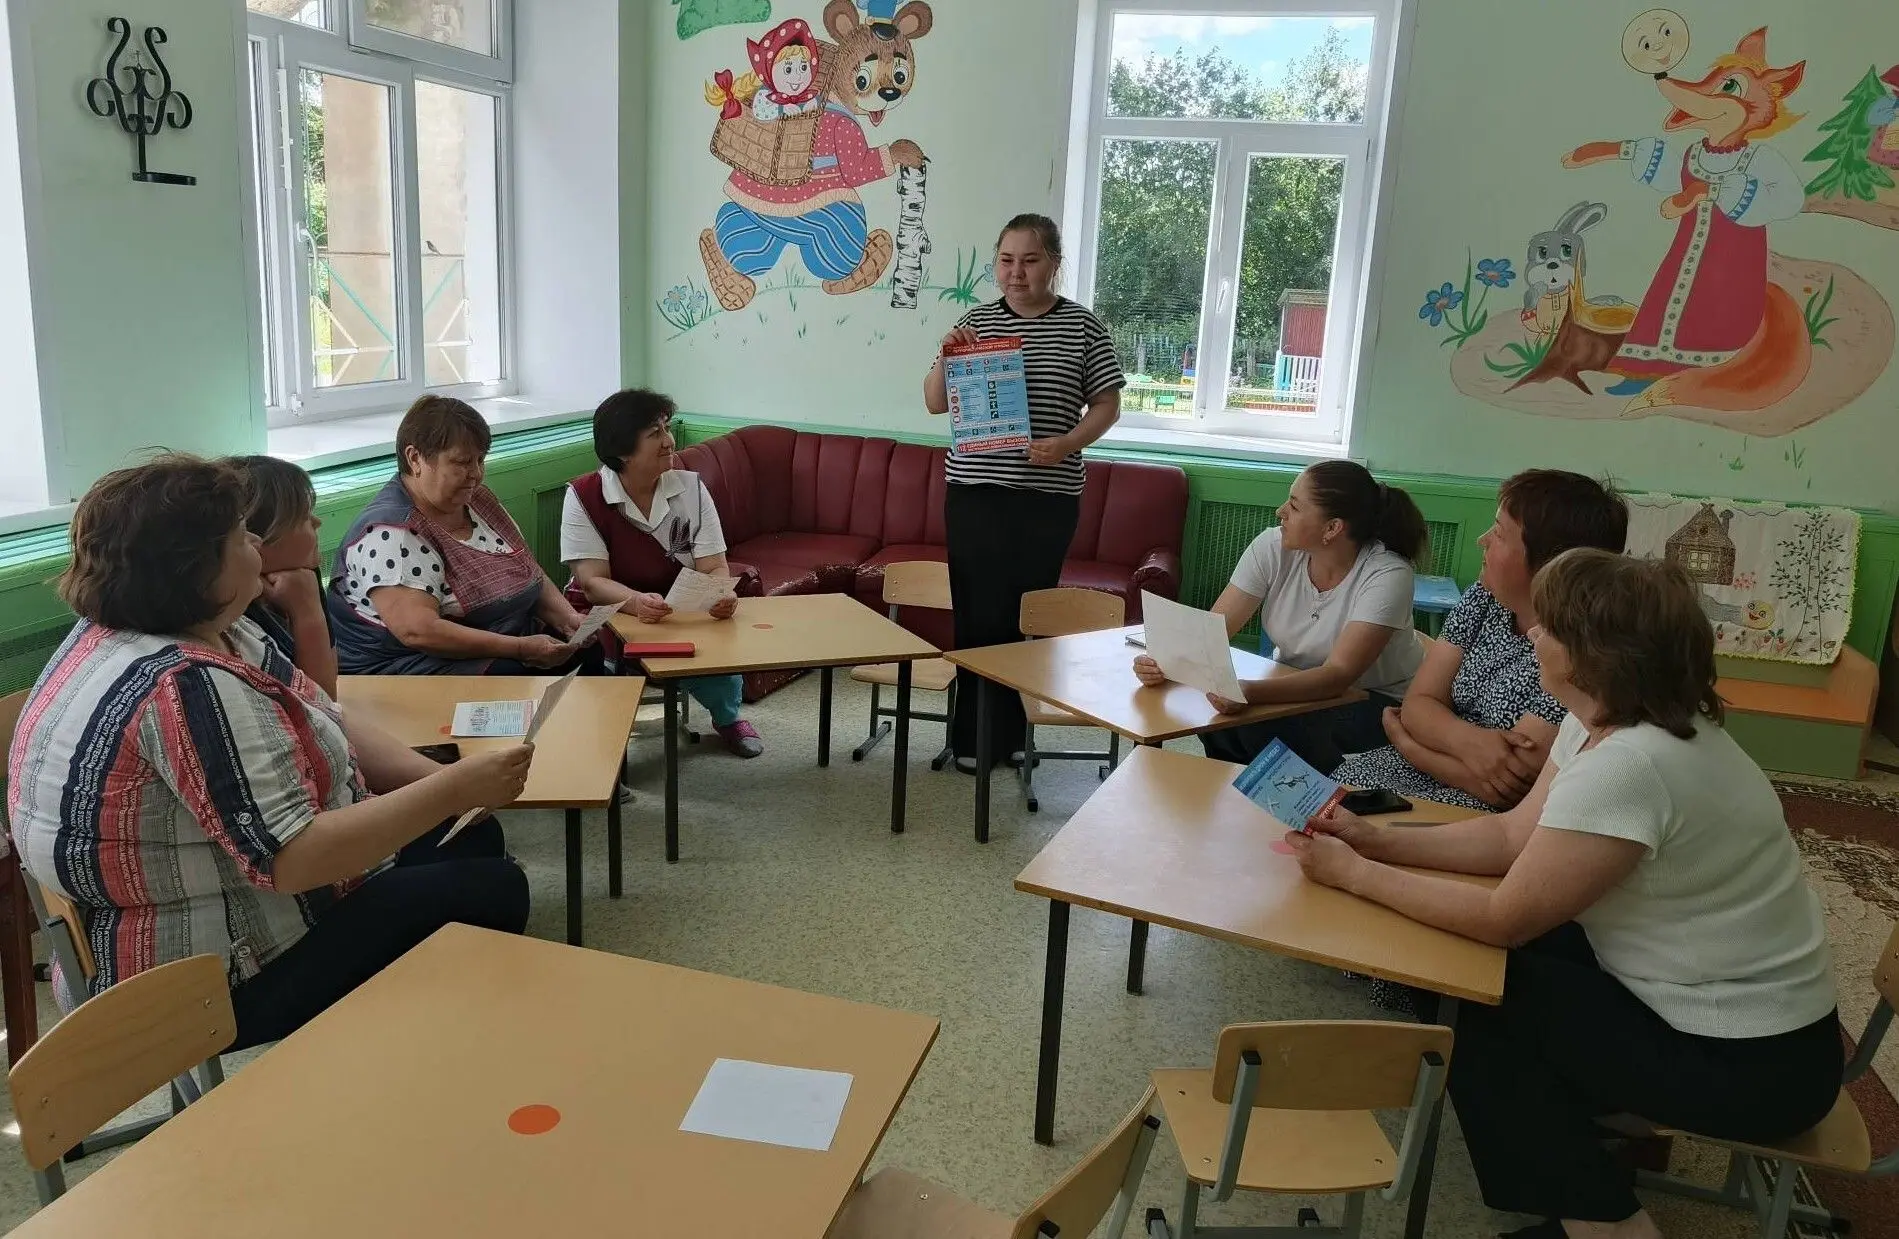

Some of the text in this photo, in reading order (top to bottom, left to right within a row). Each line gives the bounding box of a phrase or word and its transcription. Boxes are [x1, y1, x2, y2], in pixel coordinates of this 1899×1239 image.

[130, 673, 147, 693] TOKIO
[119, 688, 134, 705] RIGA
[106, 701, 124, 724] MEXICO
[91, 732, 99, 743] CITY
[101, 722, 112, 737] CITY
[177, 722, 192, 750] LONDON
[186, 749, 198, 768] HONG
[193, 767, 204, 786] KONG
[75, 859, 87, 883] LONDON
[95, 926, 105, 953] LONDON
